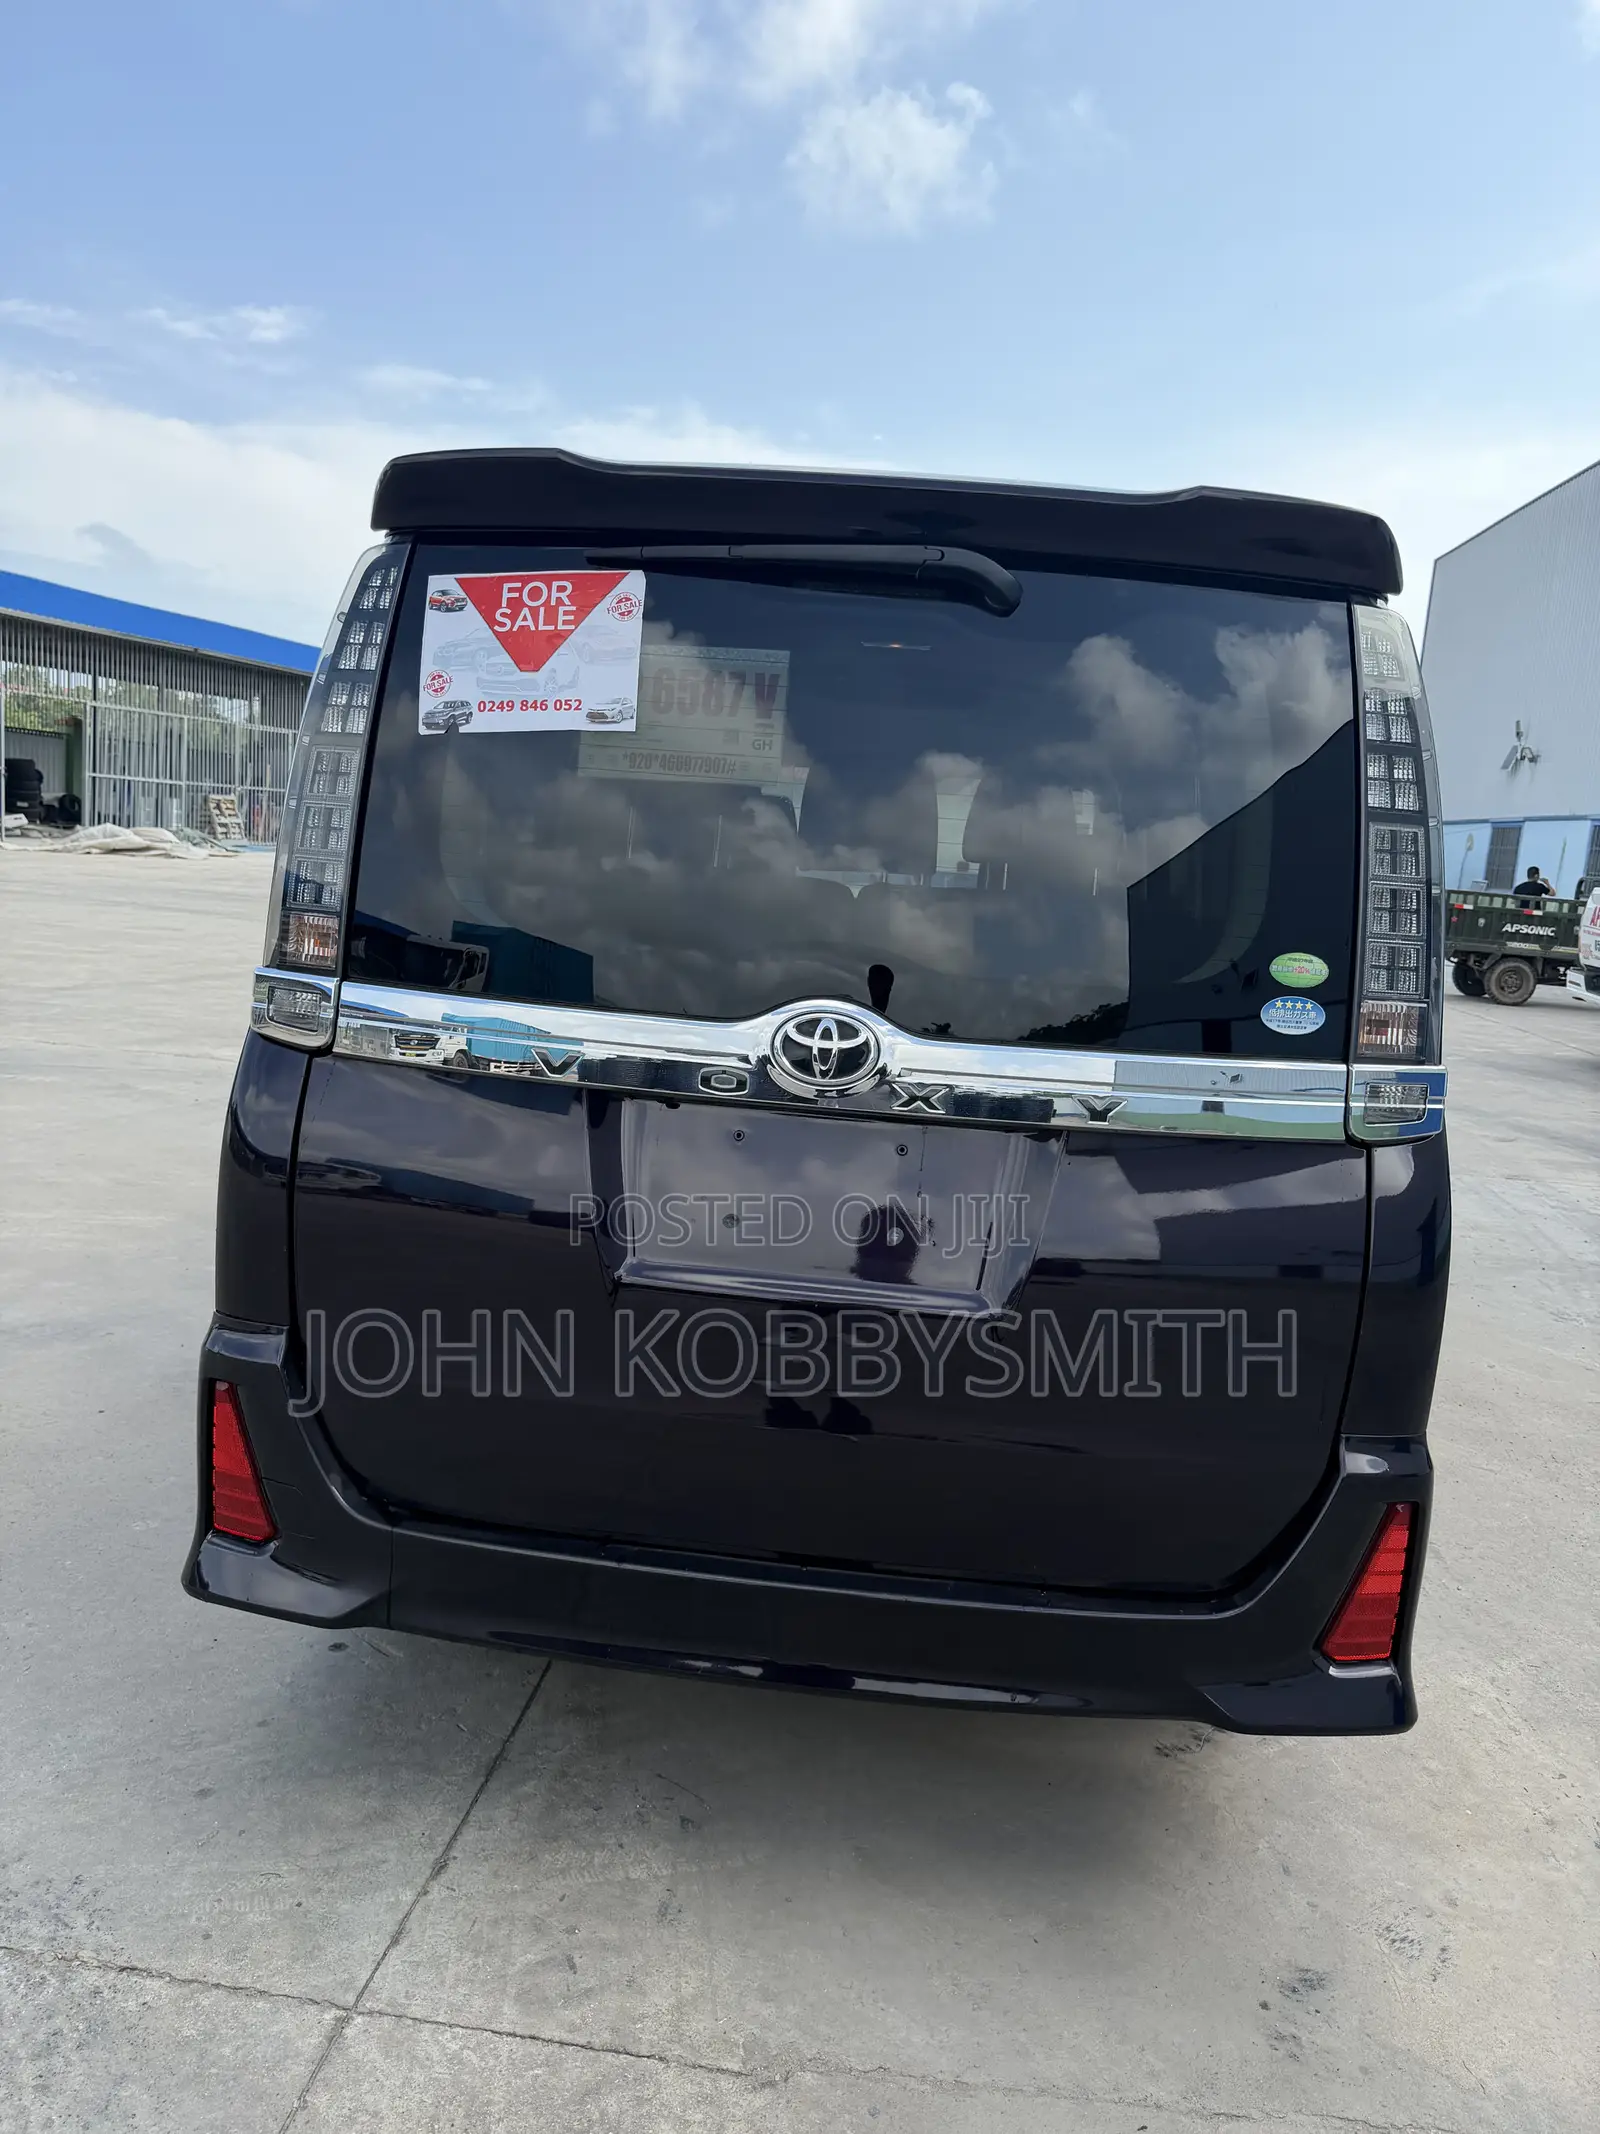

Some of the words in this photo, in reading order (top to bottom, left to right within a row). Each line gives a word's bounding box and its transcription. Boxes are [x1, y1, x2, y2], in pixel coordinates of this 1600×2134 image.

[501, 580, 573, 607] FOR
[606, 604, 622, 615] FOR
[624, 599, 643, 610] SALE
[493, 606, 577, 632] SALE
[422, 682, 436, 692] FOR
[436, 675, 454, 687] SALE
[652, 667, 746, 718] 6587
[754, 672, 781, 720] V
[477, 700, 515, 713] 0249
[519, 699, 548, 712] 846
[553, 698, 582, 711] 052
[751, 739, 773, 751] GH
[1502, 923, 1556, 936] APSONIC
[531, 1048, 1128, 1125] VOXY
